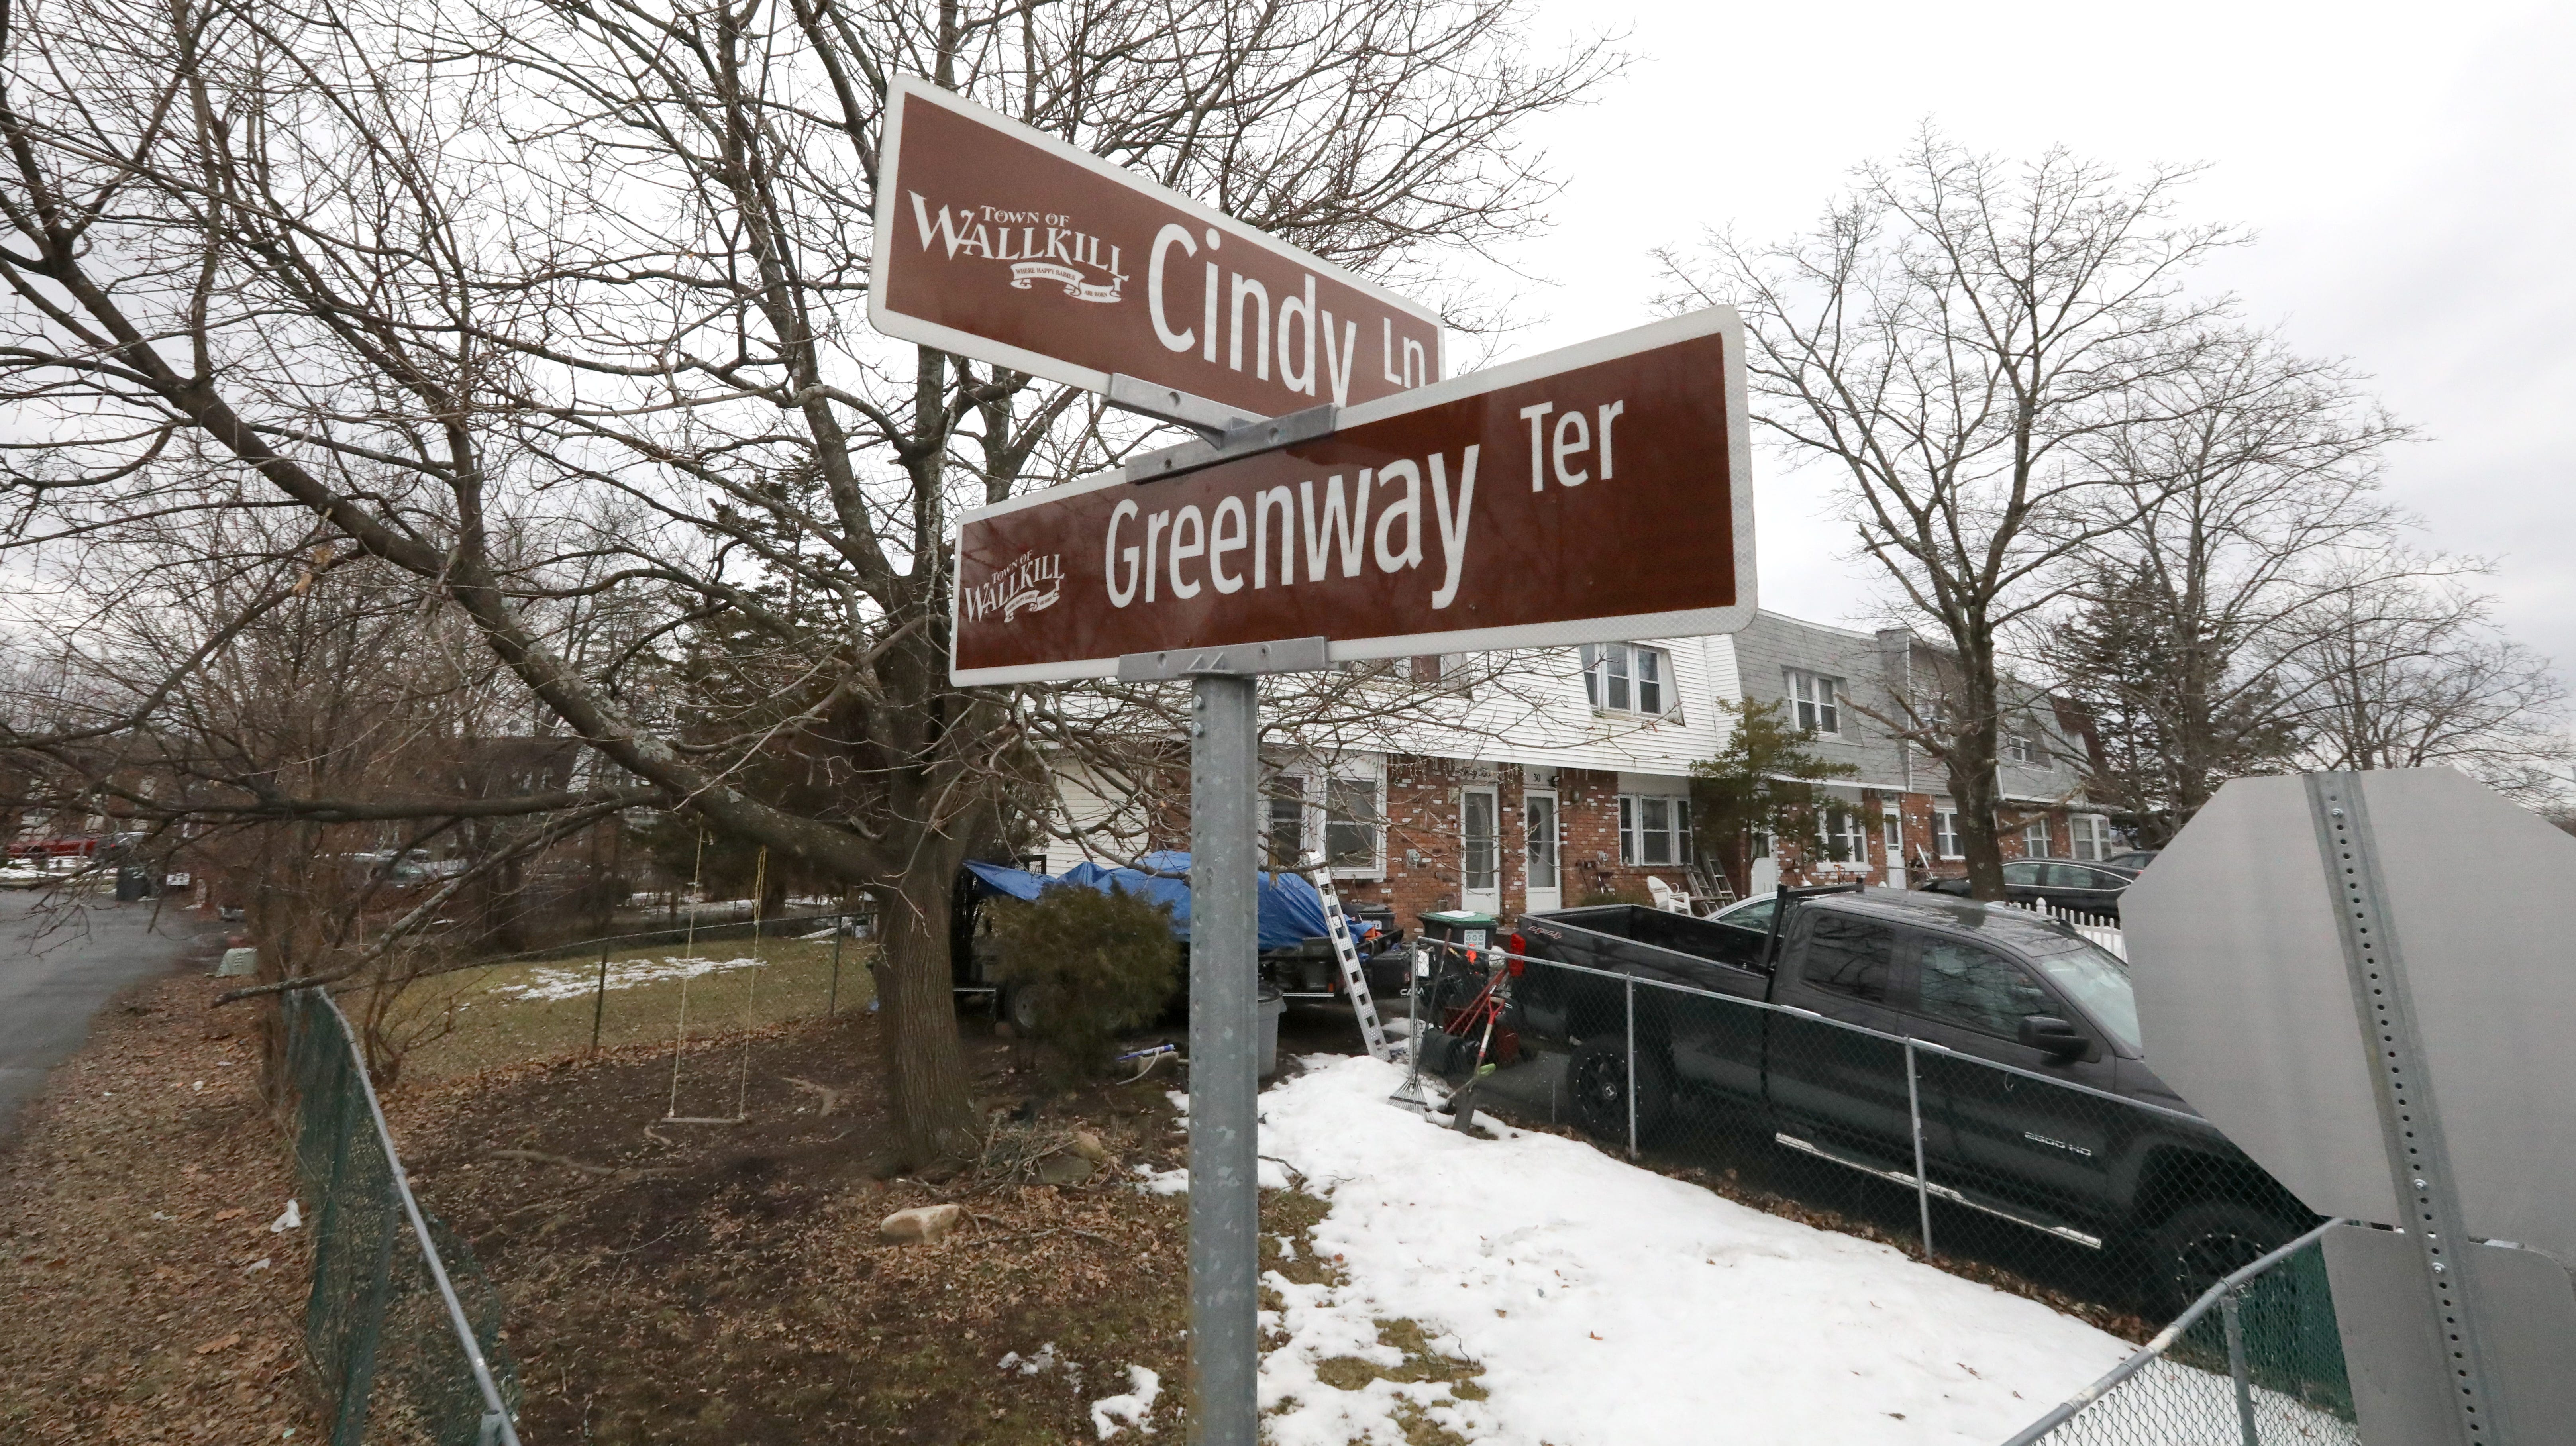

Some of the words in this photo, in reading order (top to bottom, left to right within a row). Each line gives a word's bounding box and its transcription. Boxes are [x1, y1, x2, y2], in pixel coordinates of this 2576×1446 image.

[908, 189, 1129, 282] WALLKILL
[980, 205, 1039, 223] TOWN
[1045, 213, 1069, 226] OF
[1056, 270, 1075, 280] BABIES
[1148, 223, 1357, 408] Cindy
[1384, 317, 1426, 389] Ln
[1105, 444, 1480, 610] Greenway
[1520, 400, 1624, 492] Ter
[964, 554, 1065, 623] WALLKILL
[992, 559, 1018, 584] TOWN
[1020, 550, 1033, 564] OF
[1533, 773, 1541, 782] 30
